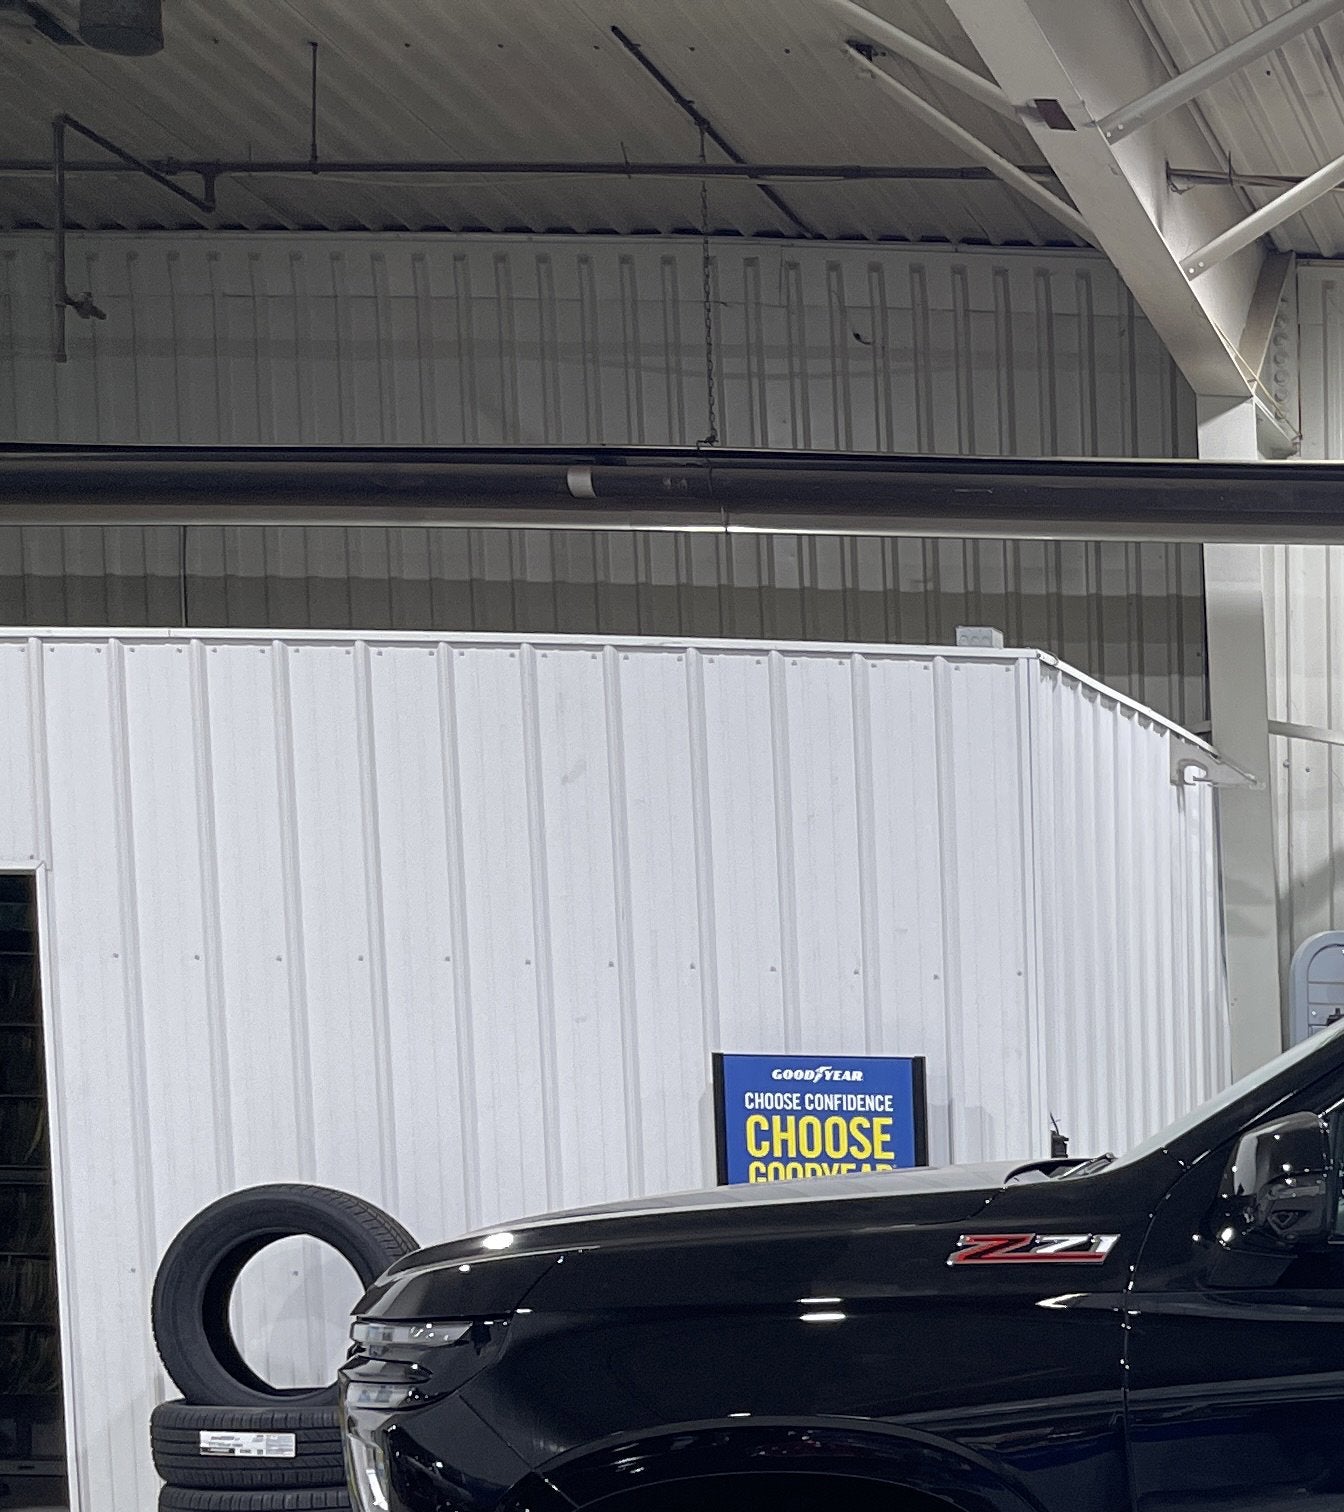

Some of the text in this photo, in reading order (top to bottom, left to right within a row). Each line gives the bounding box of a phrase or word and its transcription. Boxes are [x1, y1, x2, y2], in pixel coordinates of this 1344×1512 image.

[772, 1066, 863, 1084] GOODYEAR
[744, 1092, 894, 1112] CHOOSE CONFIDENCE
[746, 1115, 895, 1159] CHOOSE
[947, 1233, 1121, 1265] Z71
